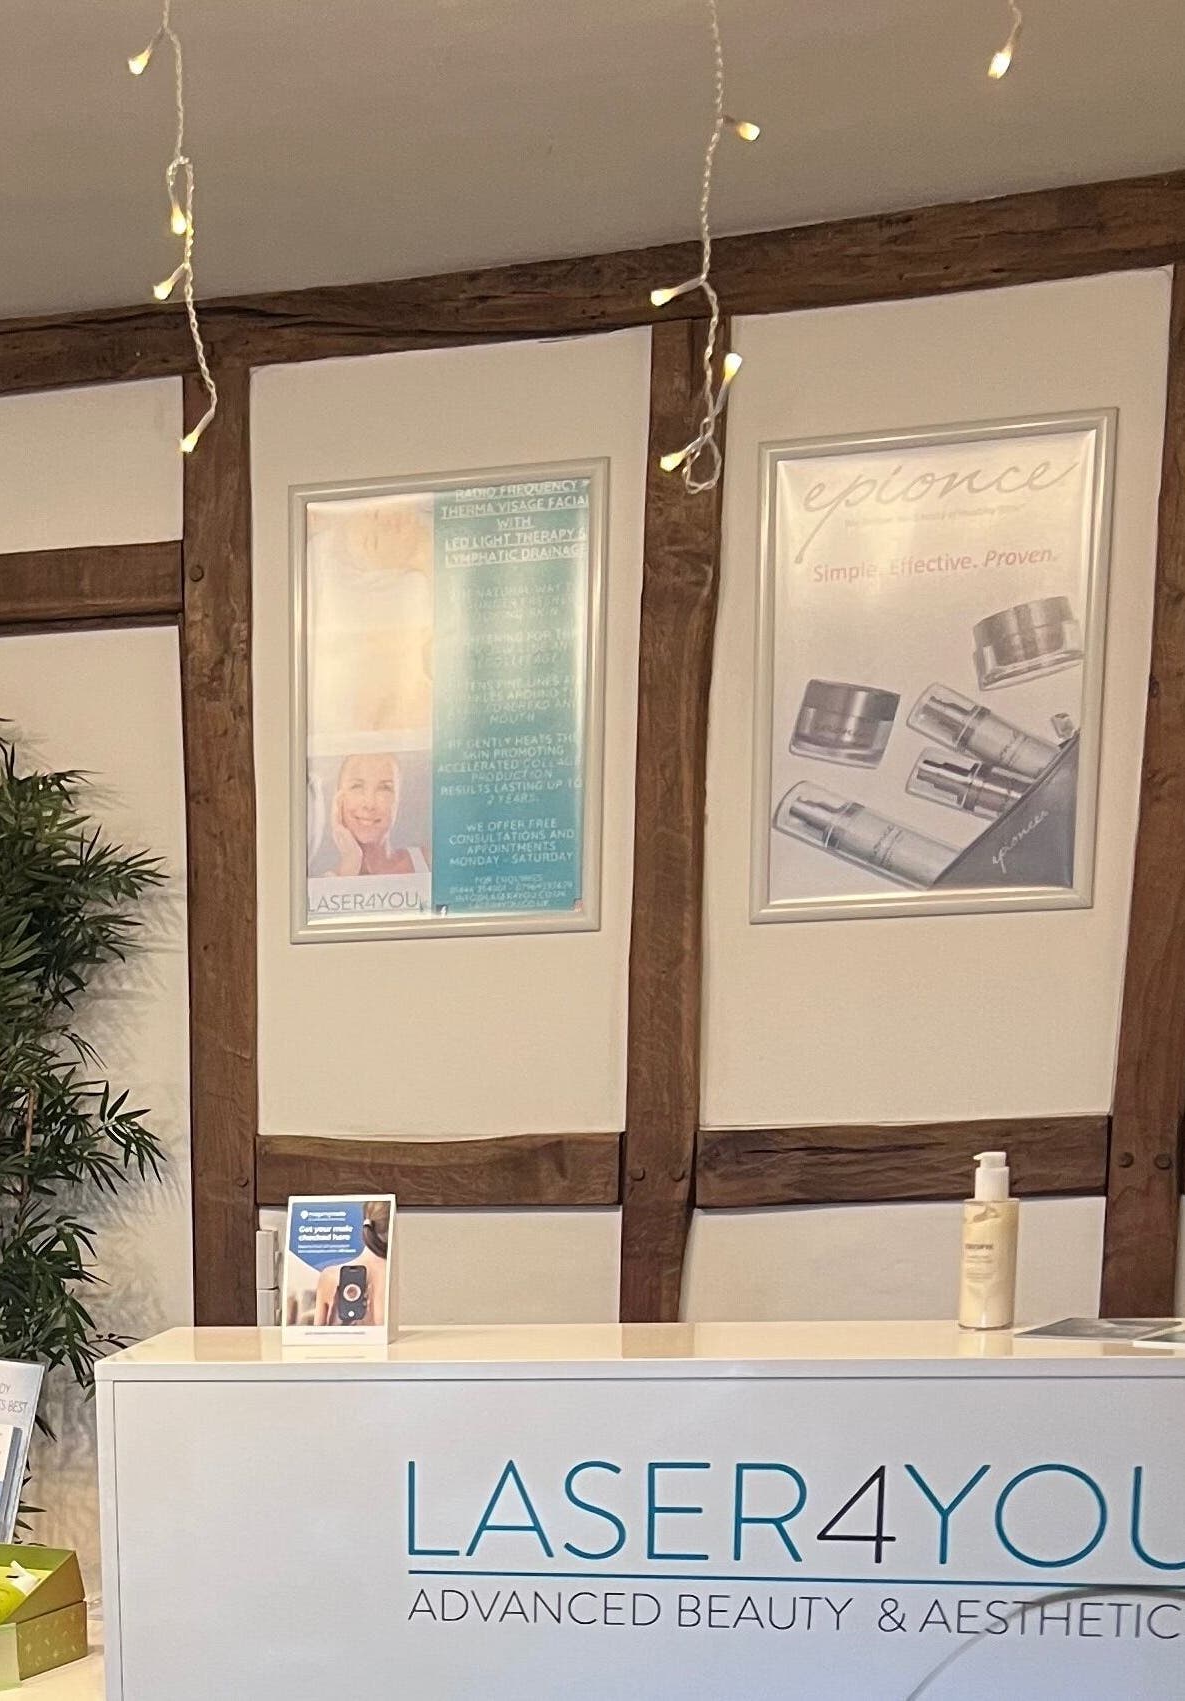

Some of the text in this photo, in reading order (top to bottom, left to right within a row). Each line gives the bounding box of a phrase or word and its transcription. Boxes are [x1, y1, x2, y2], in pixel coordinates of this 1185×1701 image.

[442, 495, 589, 518] THERMA VISAGE FACIAL
[795, 461, 1079, 564] epionce
[497, 516, 531, 530] WITH
[474, 533, 511, 547] LIGHT
[516, 529, 575, 544] THERAPY
[889, 554, 978, 578] Effective.
[983, 548, 1058, 567] Proven.
[515, 734, 553, 746] HEATS
[494, 746, 564, 759] PROMOTING
[438, 759, 519, 773] ACCELERATED
[472, 769, 553, 783] PRODUCTION
[441, 783, 489, 796] RESULTS
[494, 780, 543, 793] LASTING
[547, 779, 563, 791] UP
[466, 817, 557, 832] WE OFFER FREE
[448, 829, 575, 846] CONSULTATIONS AND
[466, 841, 556, 856] APPOINTMENTS
[450, 854, 500, 867] MONDAY
[512, 851, 574, 865] SATURDAY
[7, 1401, 28, 1413] BEST
[408, 1459, 1185, 1572] LASER4YOU
[408, 1588, 662, 1631] ADVANCED
[678, 1594, 854, 1634] BEAUTY
[879, 1598, 907, 1634] &
